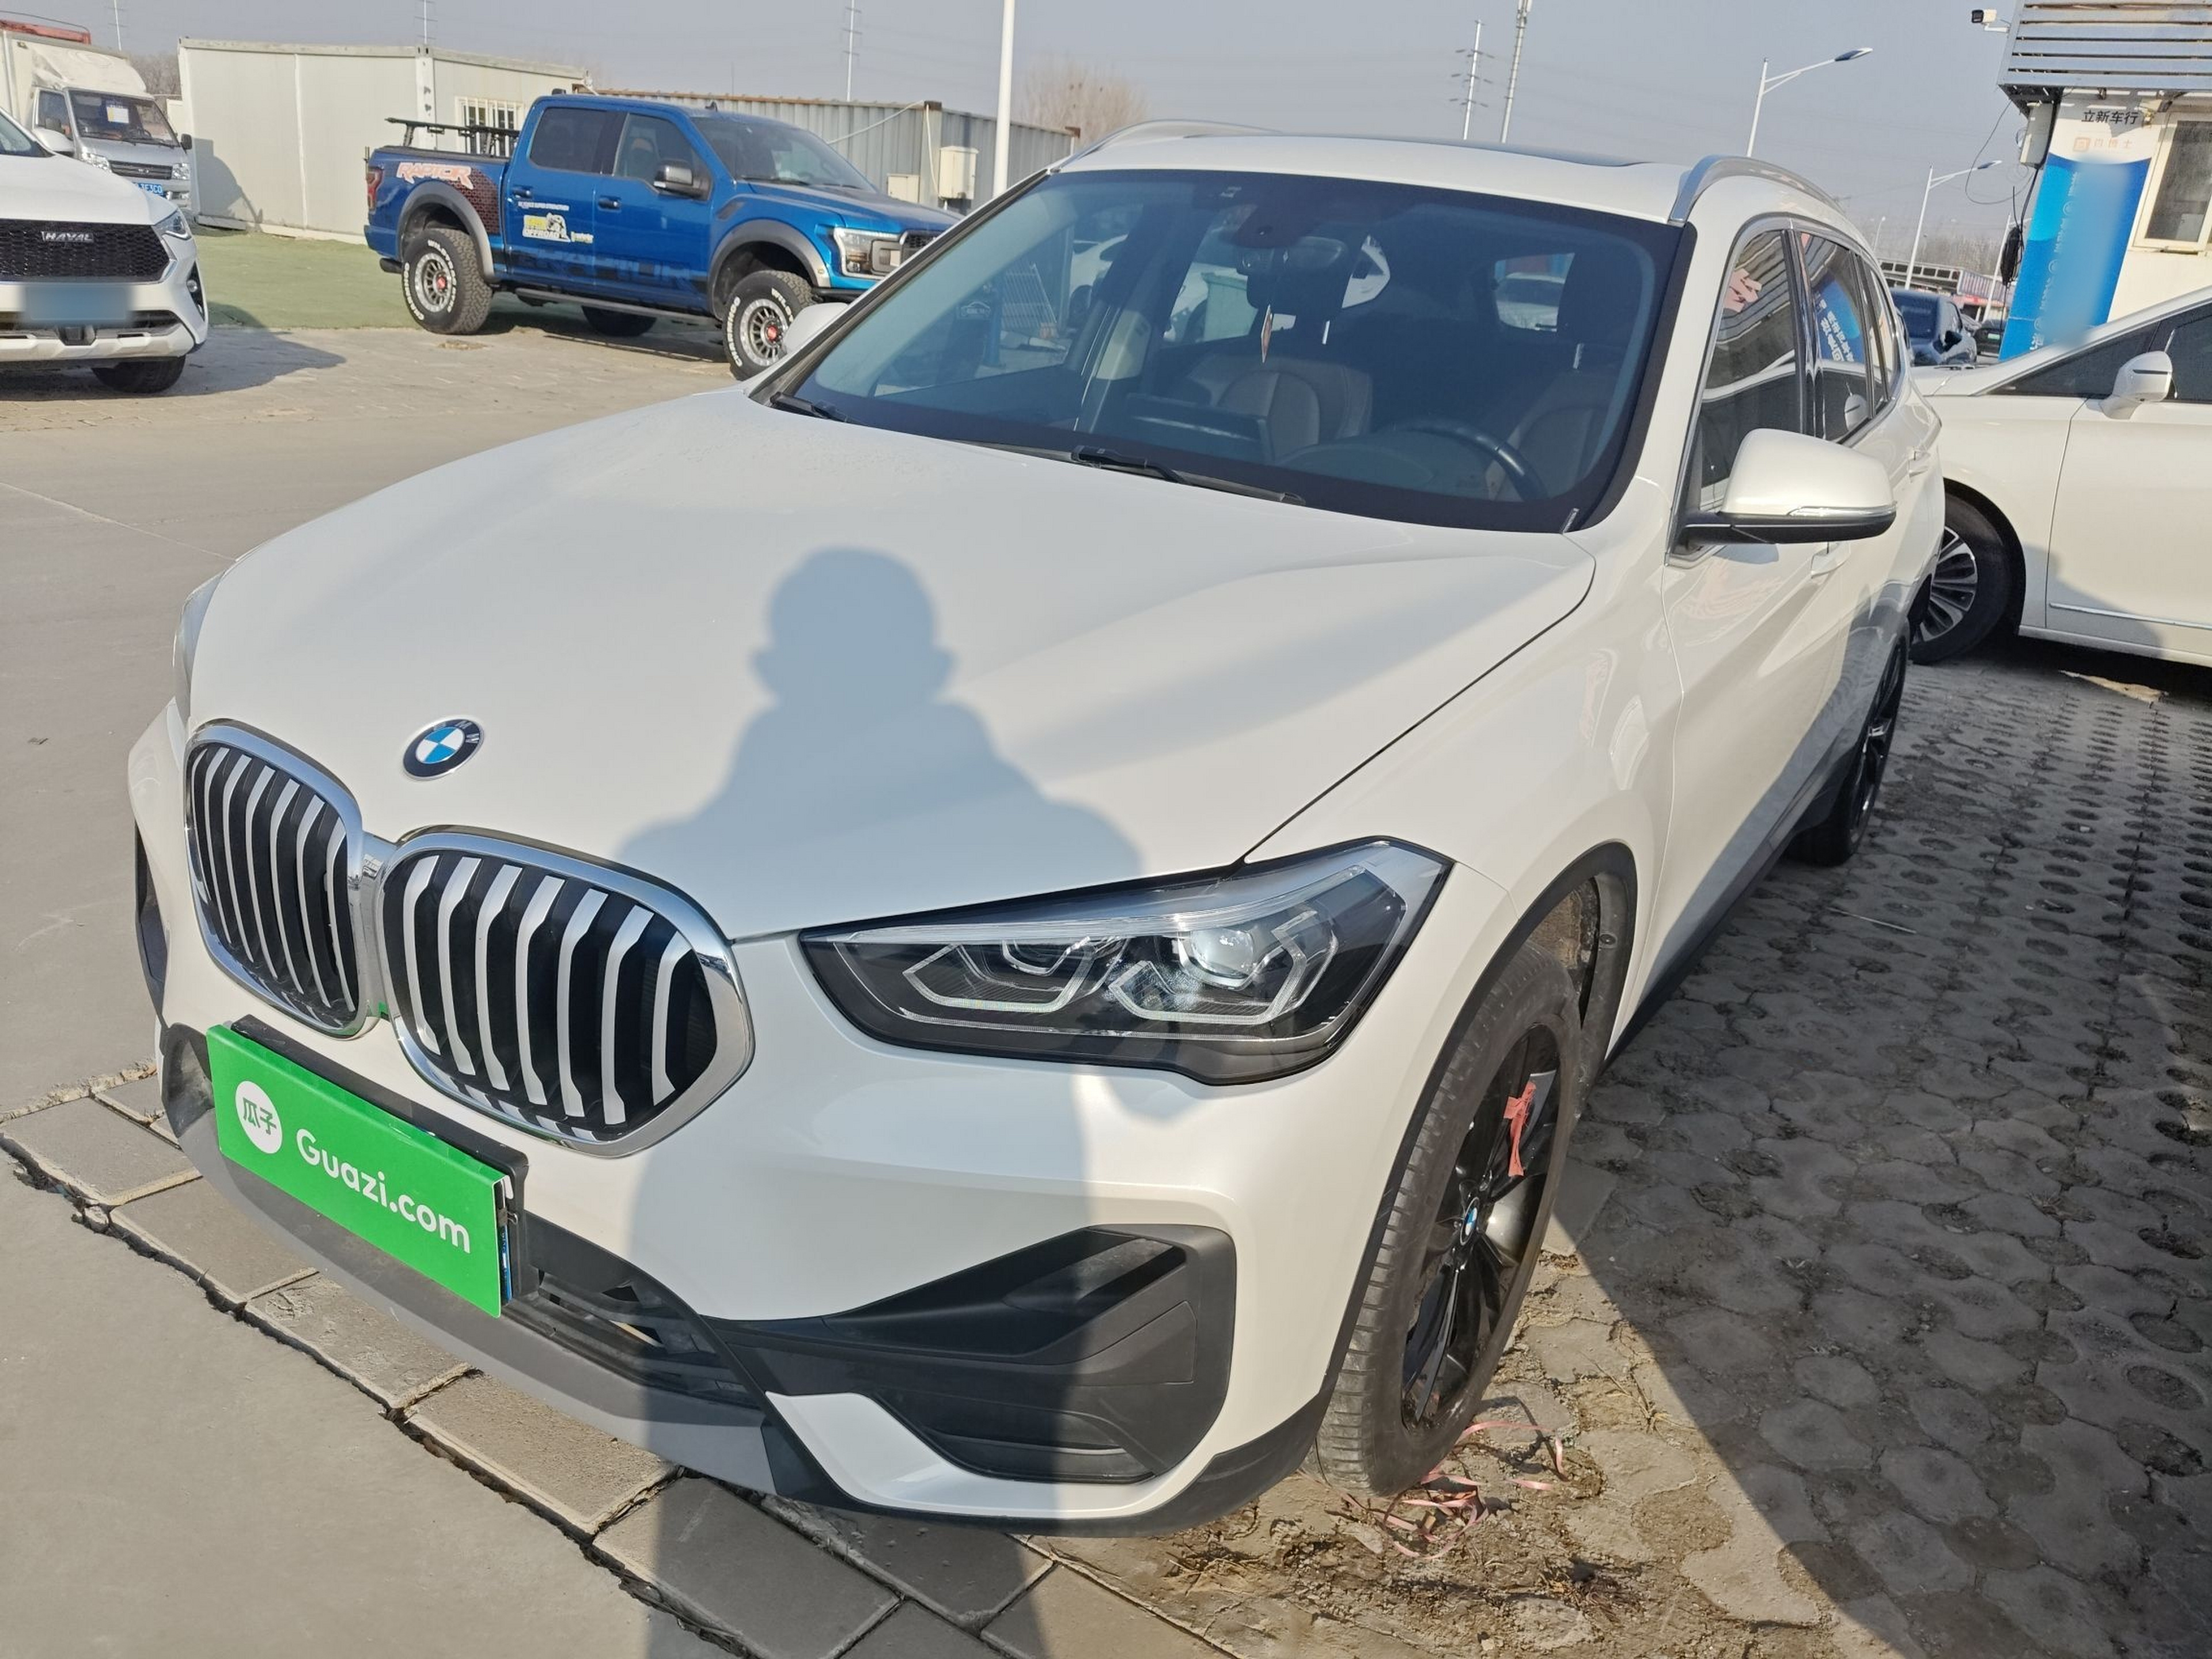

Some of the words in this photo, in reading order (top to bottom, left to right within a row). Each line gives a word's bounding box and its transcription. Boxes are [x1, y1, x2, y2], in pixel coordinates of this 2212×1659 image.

[2081, 110, 2139, 125] 立新车行
[396, 162, 474, 190] RAPTOR
[46, 232, 93, 241] HAVAL
[243, 1098, 277, 1135] 瓜子
[296, 1128, 471, 1254] Guazi.com
